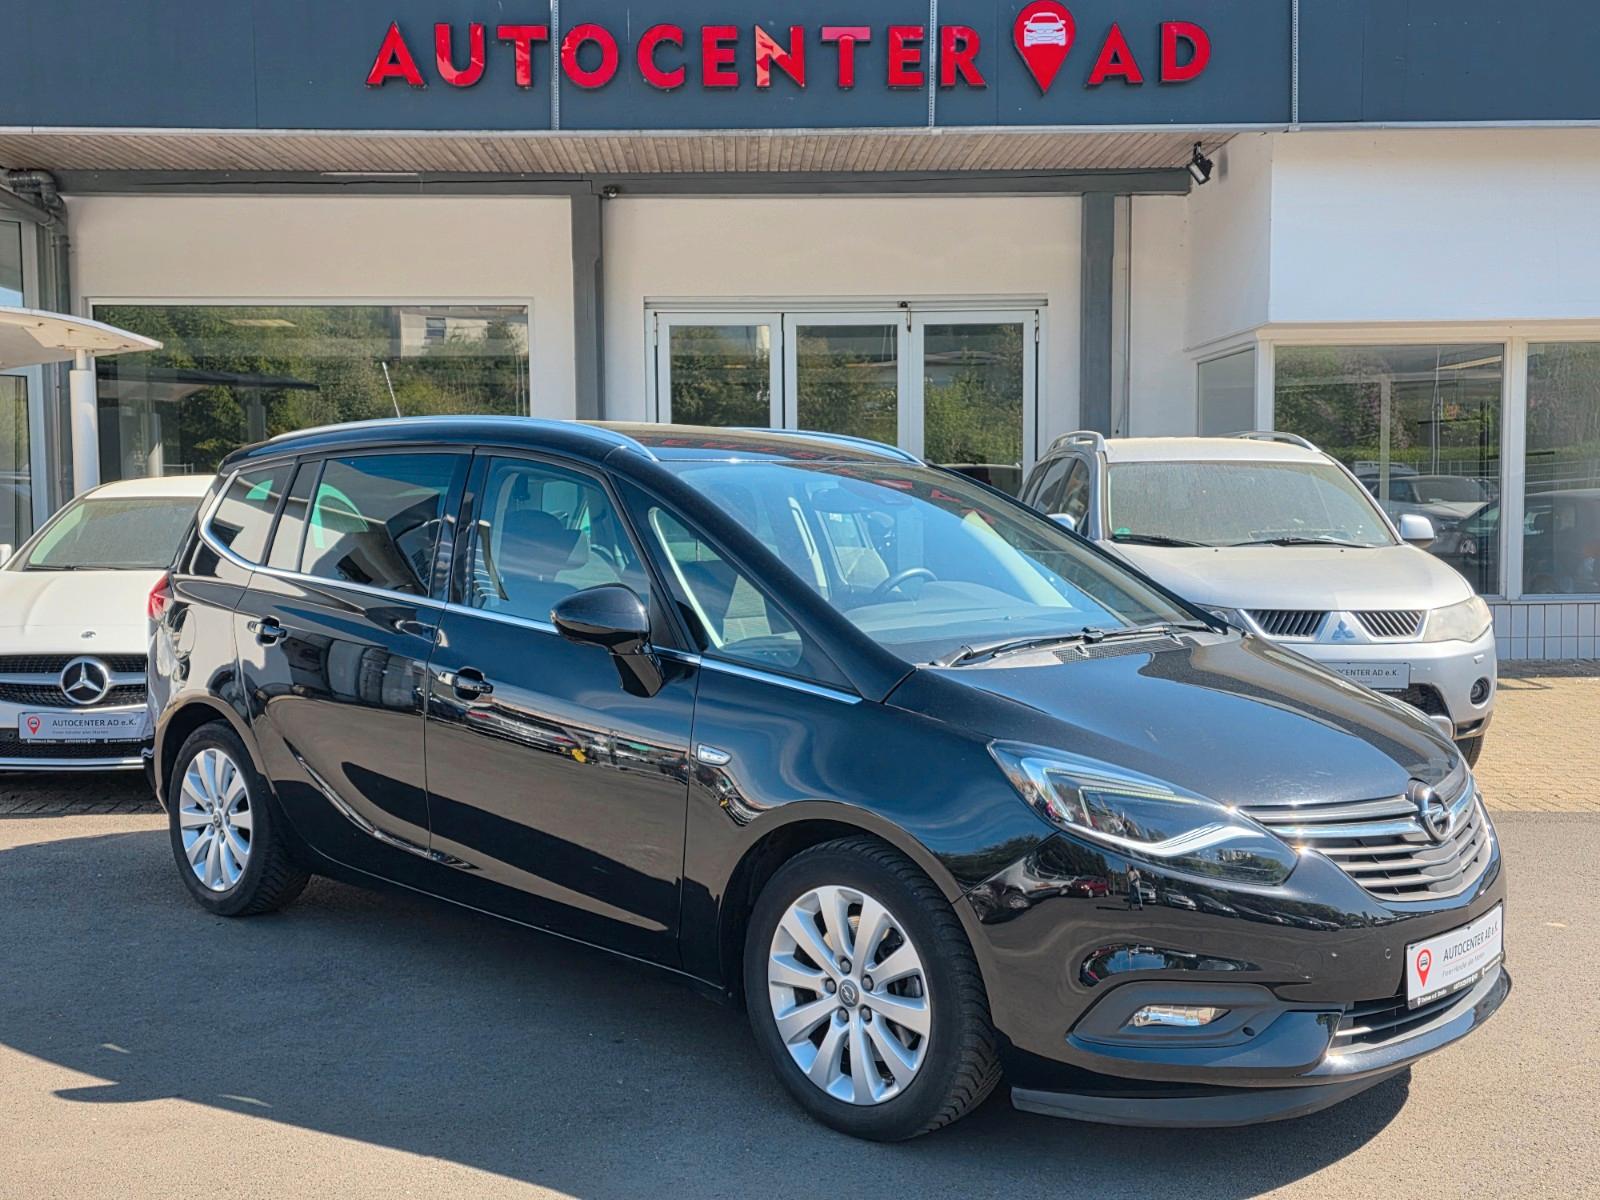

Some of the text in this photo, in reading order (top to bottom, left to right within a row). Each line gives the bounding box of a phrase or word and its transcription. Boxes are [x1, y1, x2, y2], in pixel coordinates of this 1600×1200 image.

[366, 21, 1212, 91] AUTOCENTER AD
[52, 719, 105, 727] AUTOCENTER
[1443, 932, 1484, 961] AUTOCENTER
